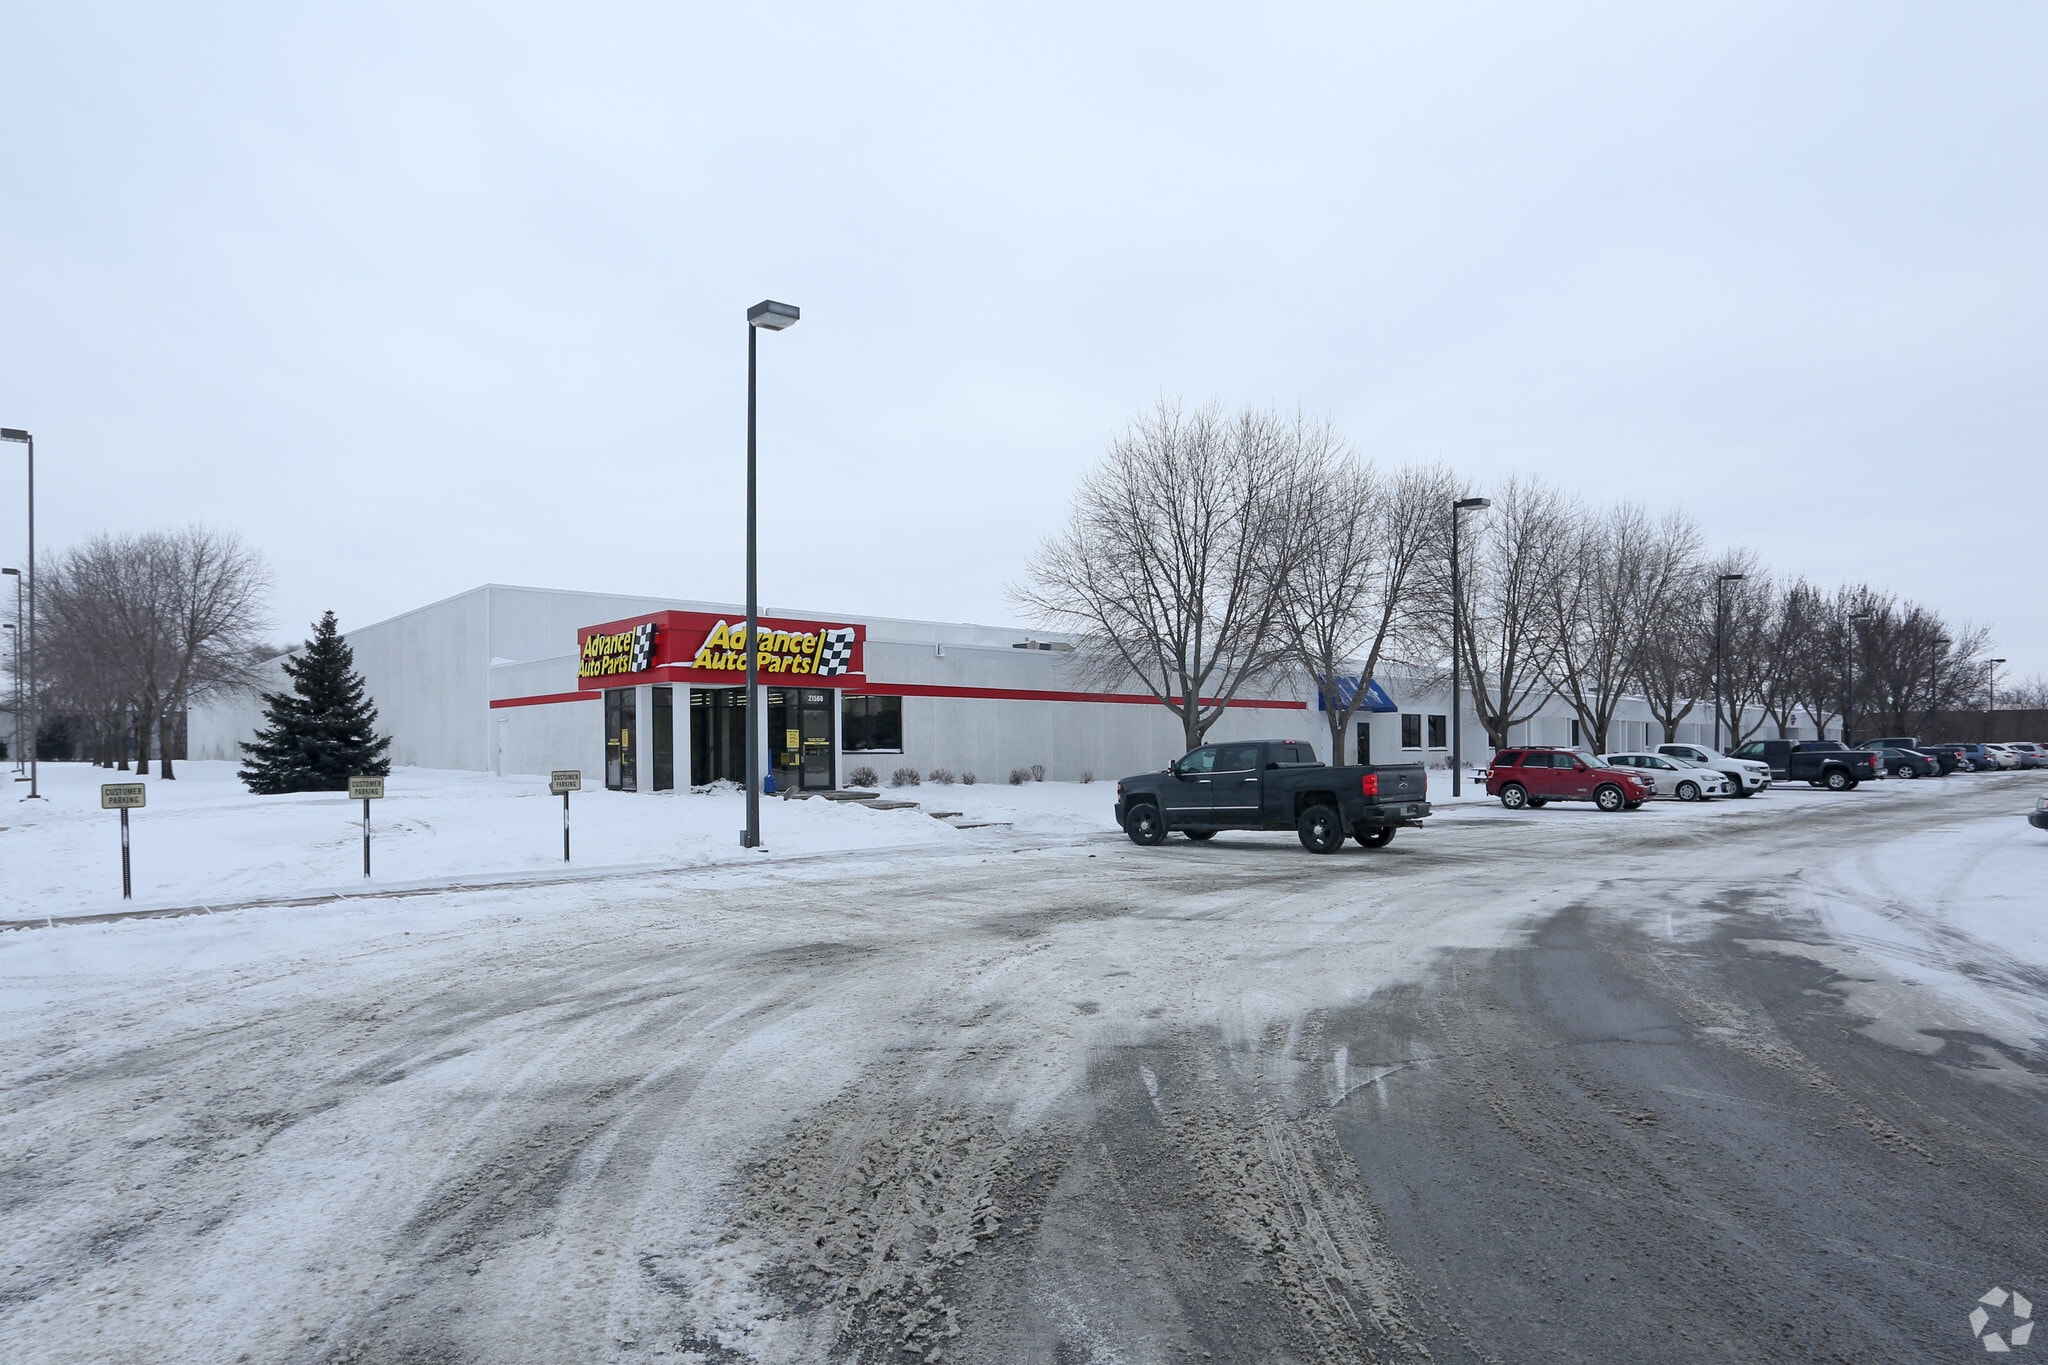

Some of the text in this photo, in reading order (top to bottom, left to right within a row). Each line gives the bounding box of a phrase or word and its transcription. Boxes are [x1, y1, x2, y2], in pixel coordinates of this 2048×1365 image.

[583, 633, 631, 658] Advance
[578, 653, 628, 678] Auto Parts
[692, 649, 811, 674] Auto Parts
[105, 788, 142, 796] CUSTOMER
[352, 780, 382, 788] CUSTOMER
[109, 796, 139, 804] PARKING
